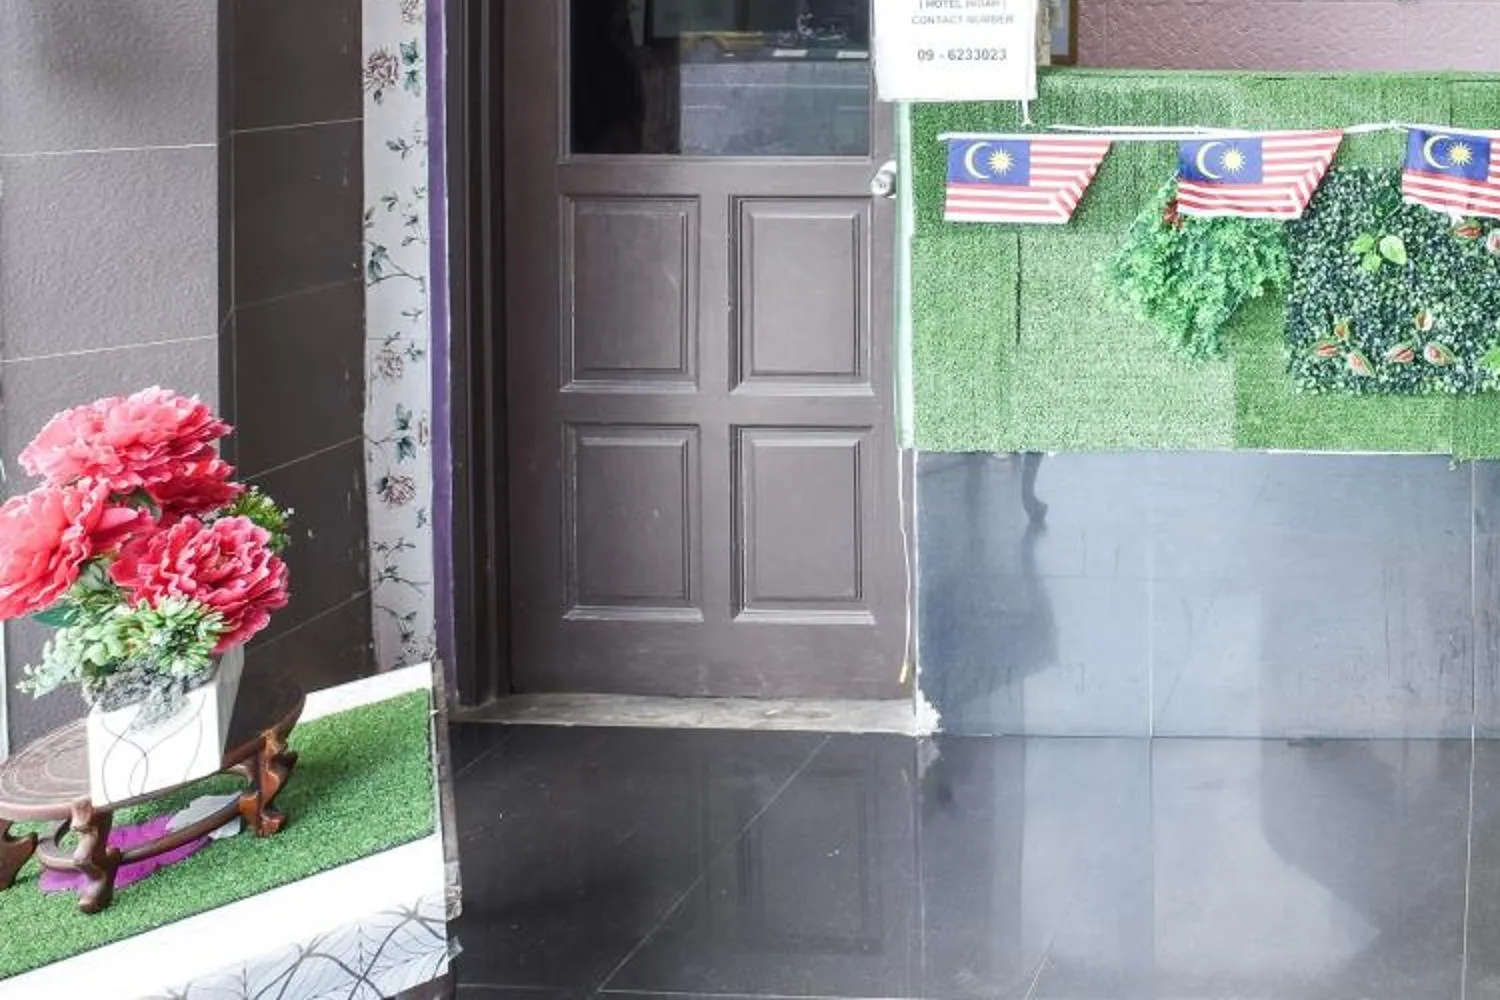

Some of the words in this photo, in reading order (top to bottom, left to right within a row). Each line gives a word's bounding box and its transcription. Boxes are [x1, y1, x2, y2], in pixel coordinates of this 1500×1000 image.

[925, 0, 962, 9] HOTEL
[911, 14, 962, 25] CONTACT
[965, 14, 1014, 25] NUMBER
[917, 48, 935, 61] 09
